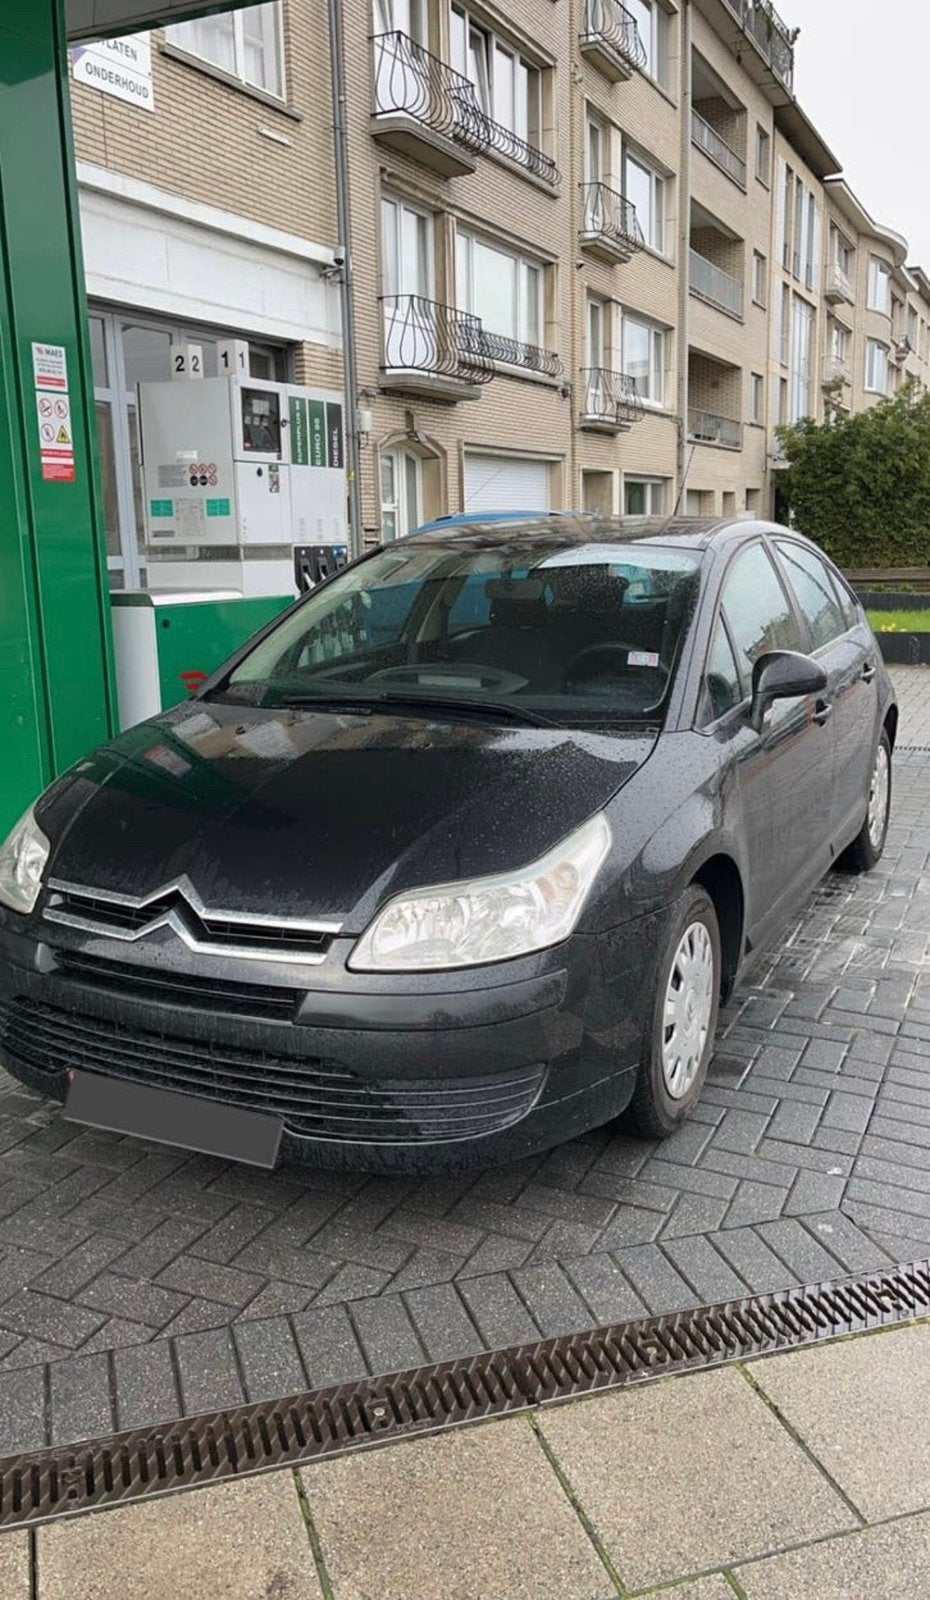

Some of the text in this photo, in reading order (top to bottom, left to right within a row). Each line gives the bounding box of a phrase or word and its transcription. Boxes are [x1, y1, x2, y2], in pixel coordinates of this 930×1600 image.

[85, 62, 149, 99] ONDERHOUD
[45, 348, 63, 357] MAES
[221, 351, 229, 368] 1
[239, 352, 245, 368] 1
[175, 355, 185, 372] 2
[191, 355, 200, 372] 2
